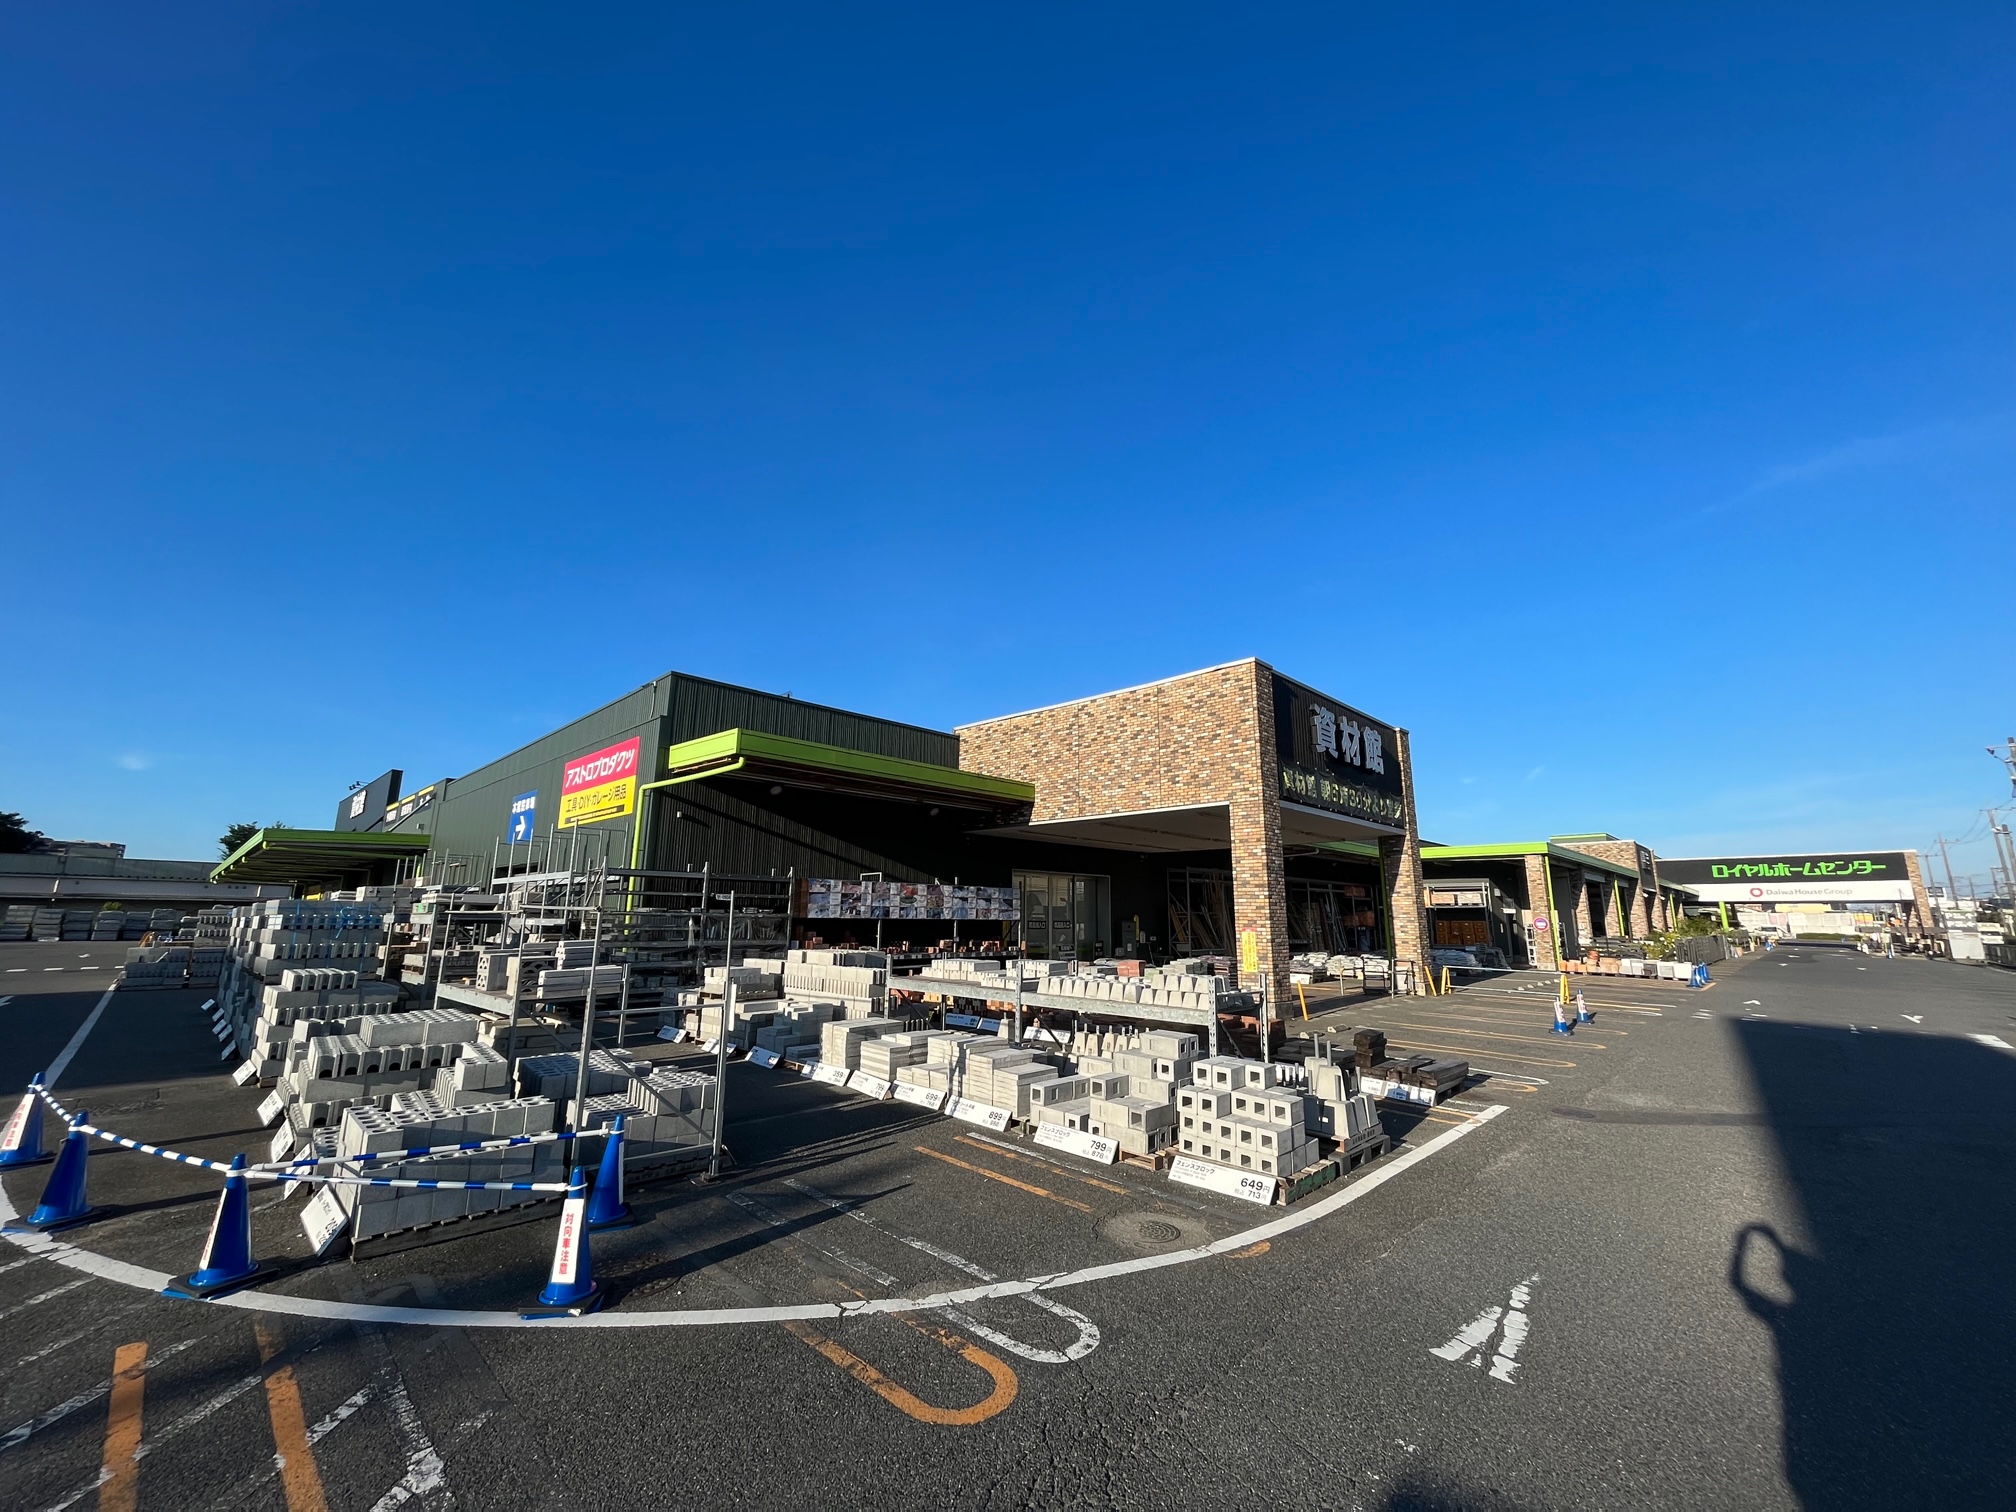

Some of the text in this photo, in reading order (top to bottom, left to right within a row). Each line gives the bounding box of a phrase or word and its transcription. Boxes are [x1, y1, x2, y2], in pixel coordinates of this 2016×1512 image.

[1310, 704, 1384, 775] 資材館
[565, 748, 635, 788] アストロプロダクツ
[1711, 860, 1887, 878] ロイヤルホームセンター
[1823, 888, 1853, 896] Group
[1175, 1159, 1216, 1175] フェンスブロック
[559, 1212, 575, 1275] 対向車注意
